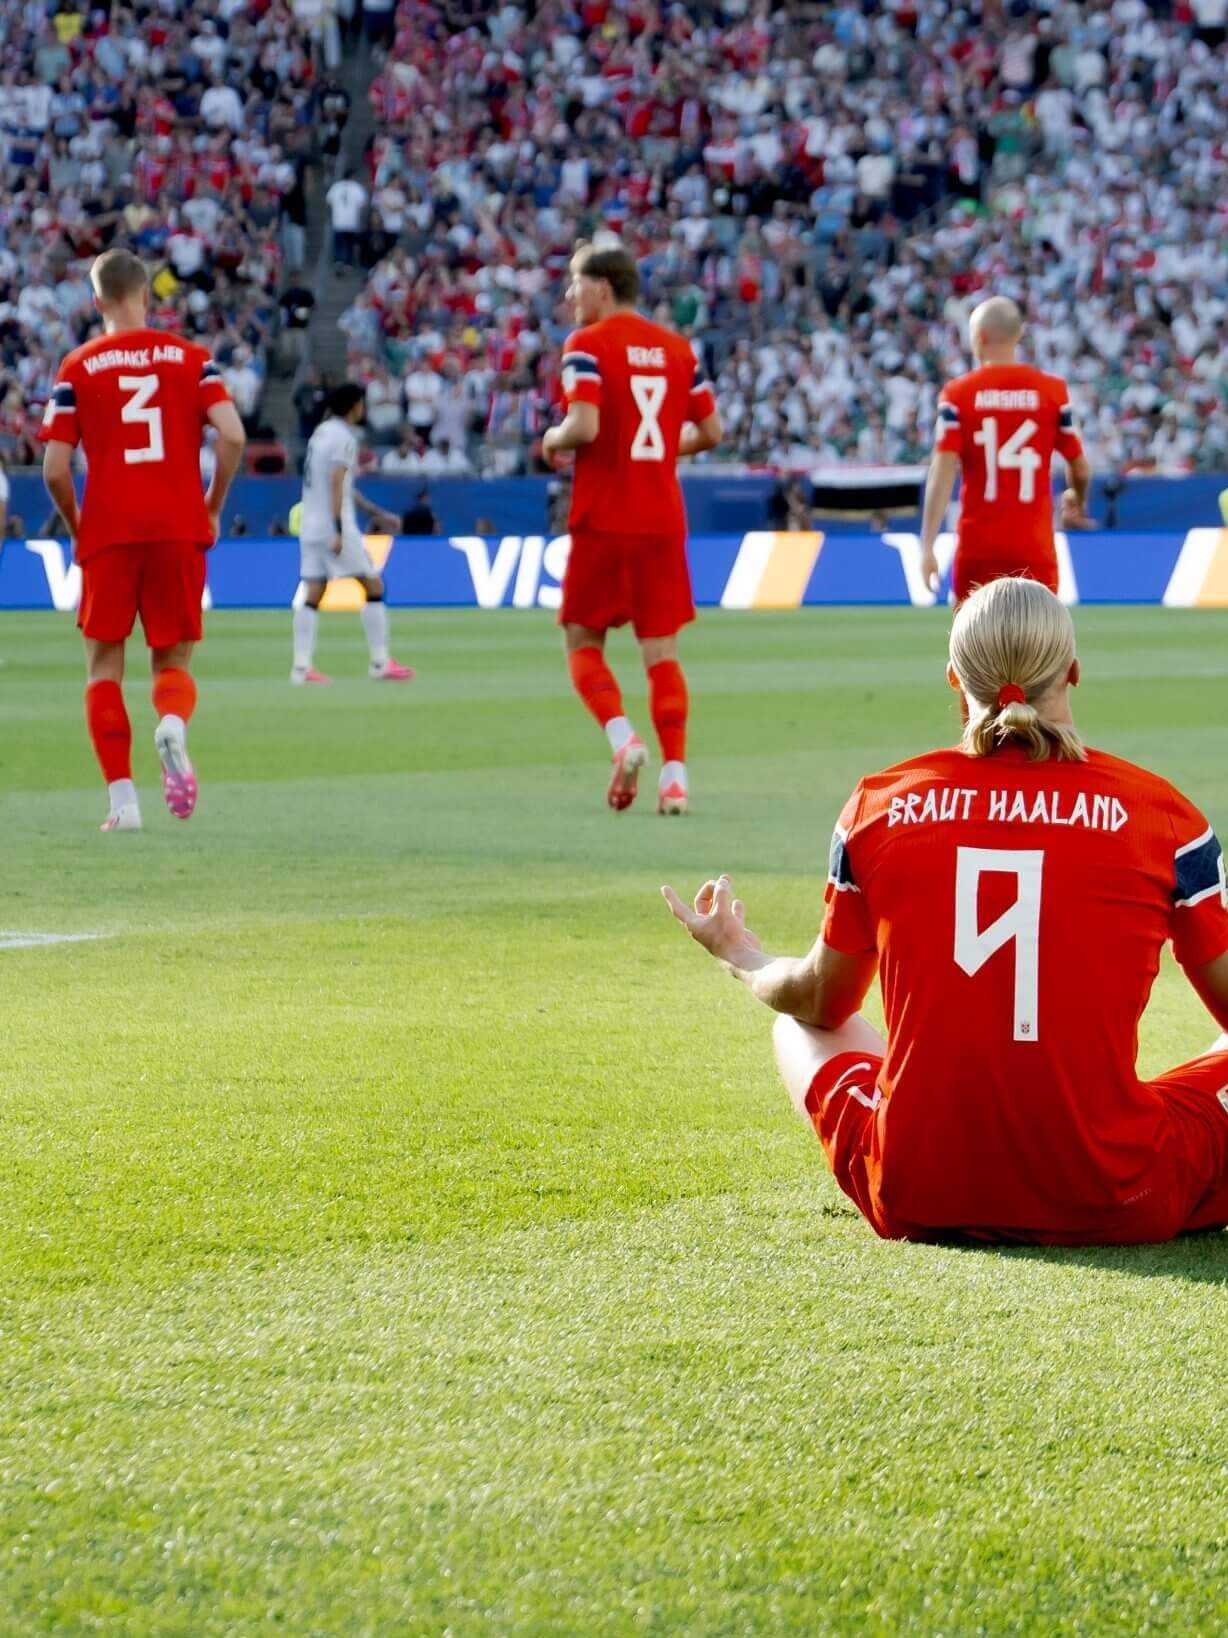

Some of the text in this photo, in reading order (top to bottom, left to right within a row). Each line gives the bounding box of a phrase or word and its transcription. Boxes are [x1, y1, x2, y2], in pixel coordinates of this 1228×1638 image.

[118, 373, 165, 465] 3
[630, 375, 668, 462] 8
[973, 416, 1042, 503] 14
[448, 534, 573, 608] VIS
[888, 788, 1129, 833] BRAUT HAALAND
[953, 845, 1045, 1042] 9
